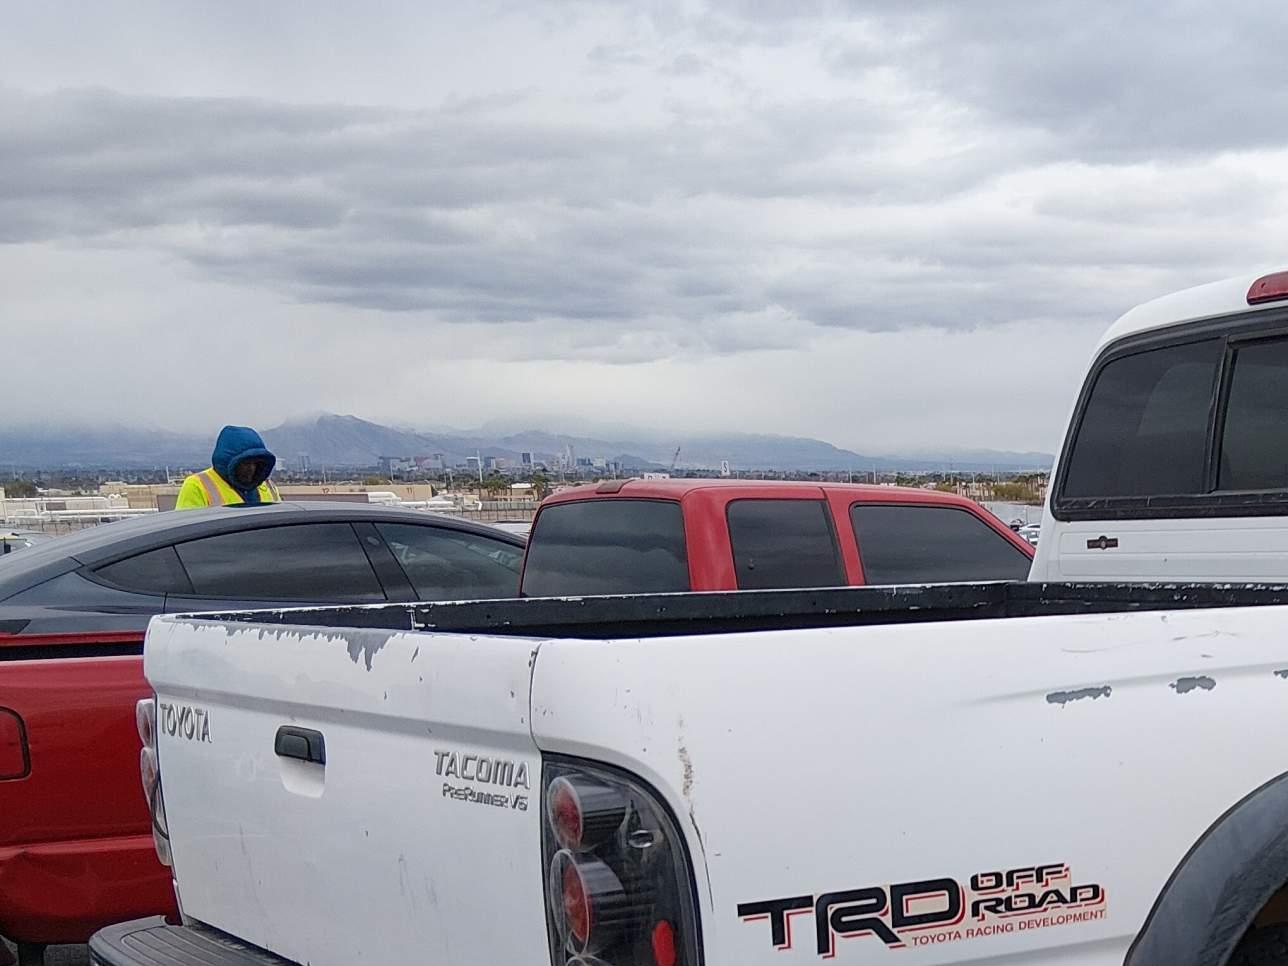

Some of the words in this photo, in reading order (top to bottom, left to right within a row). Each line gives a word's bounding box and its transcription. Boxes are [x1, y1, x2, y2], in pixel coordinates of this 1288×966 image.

[160, 703, 212, 744] TOYOTA
[434, 751, 530, 790] TACOMA
[510, 793, 529, 811] V6
[970, 863, 1068, 895] OFF
[737, 877, 965, 958] TRD
[971, 884, 1104, 920] ROAD
[912, 932, 962, 946] TOYOTA
[966, 922, 1014, 939] RACING
[1018, 909, 1105, 931] DEVELOPMENT
